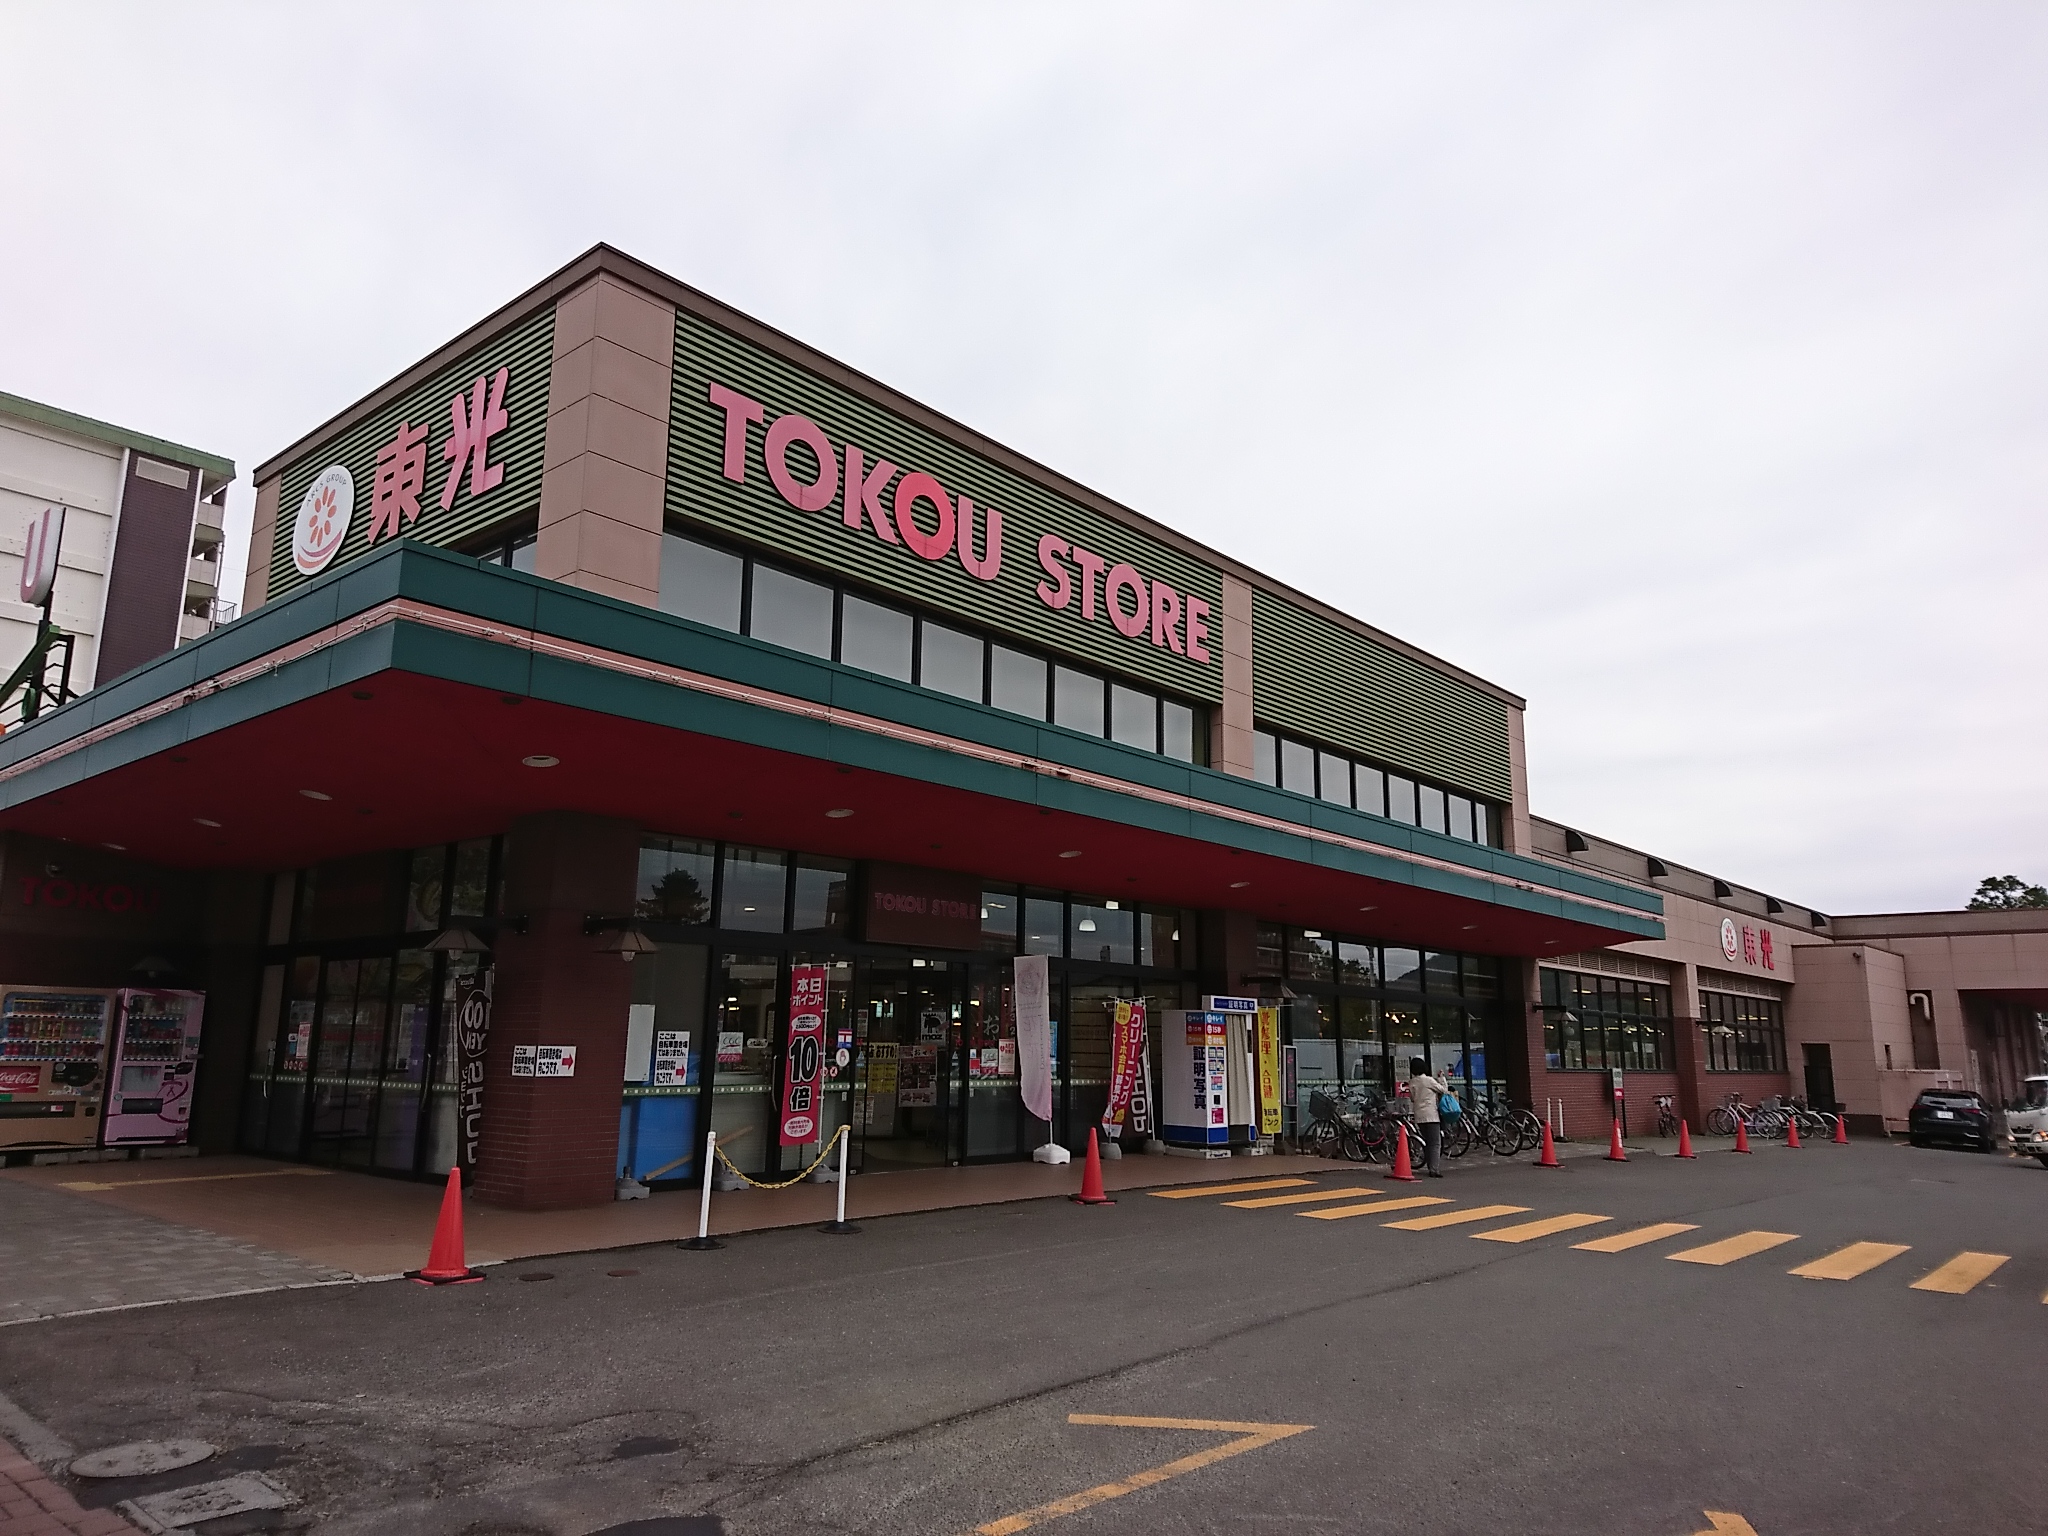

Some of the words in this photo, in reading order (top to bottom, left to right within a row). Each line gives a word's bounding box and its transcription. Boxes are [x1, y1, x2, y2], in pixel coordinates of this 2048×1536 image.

[368, 367, 509, 545] 東光
[327, 474, 347, 486] GROUP
[709, 382, 1003, 581] TOKOU
[1036, 533, 1210, 665] STORE
[20, 877, 159, 914] TOKOU
[875, 893, 927, 914] TOKOU
[932, 899, 977, 920] STORE
[1743, 925, 1775, 970] 東光
[793, 994, 823, 1007] ポイント
[797, 977, 822, 993] 本日
[789, 1036, 820, 1083] 10
[1119, 1013, 1141, 1105] クリーニング
[1193, 1046, 1207, 1109] 証明写真
[790, 1085, 812, 1112] 倍
